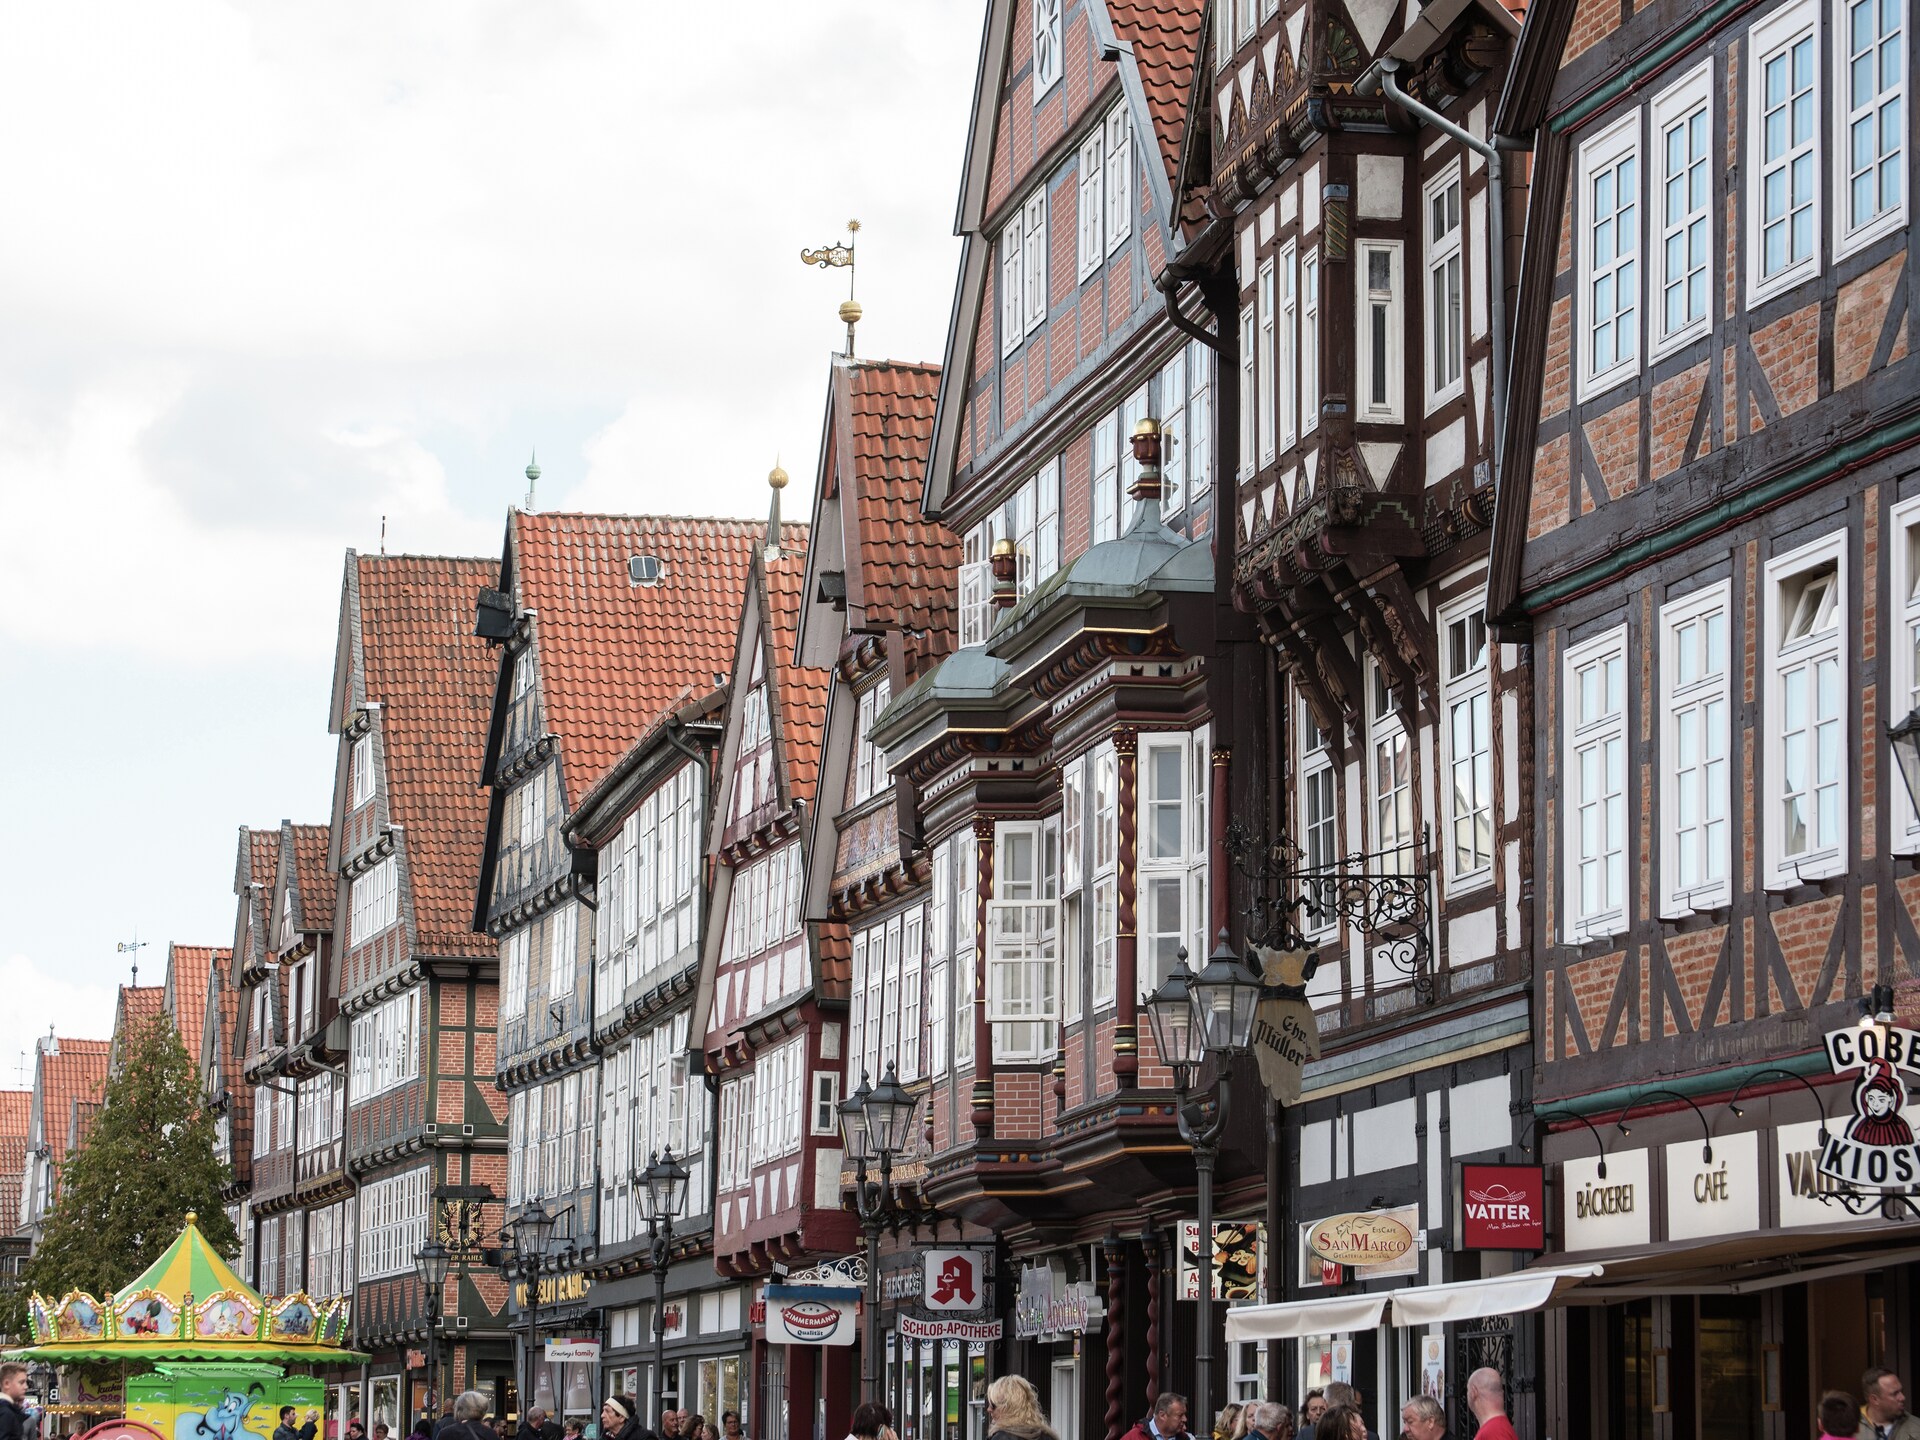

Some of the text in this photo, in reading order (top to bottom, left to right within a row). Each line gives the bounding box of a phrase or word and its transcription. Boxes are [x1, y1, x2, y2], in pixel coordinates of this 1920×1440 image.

[1253, 1019, 1304, 1066] Müller
[1824, 1139, 1920, 1184] KIOS
[1693, 1160, 1729, 1203] CAFÉ
[1465, 1203, 1530, 1220] VATTER
[1576, 1182, 1634, 1218] BÄCKEREI
[1186, 1224, 1217, 1236] Sui
[784, 1310, 837, 1326] ZIMMERMANN
[574, 1349, 594, 1358] family
